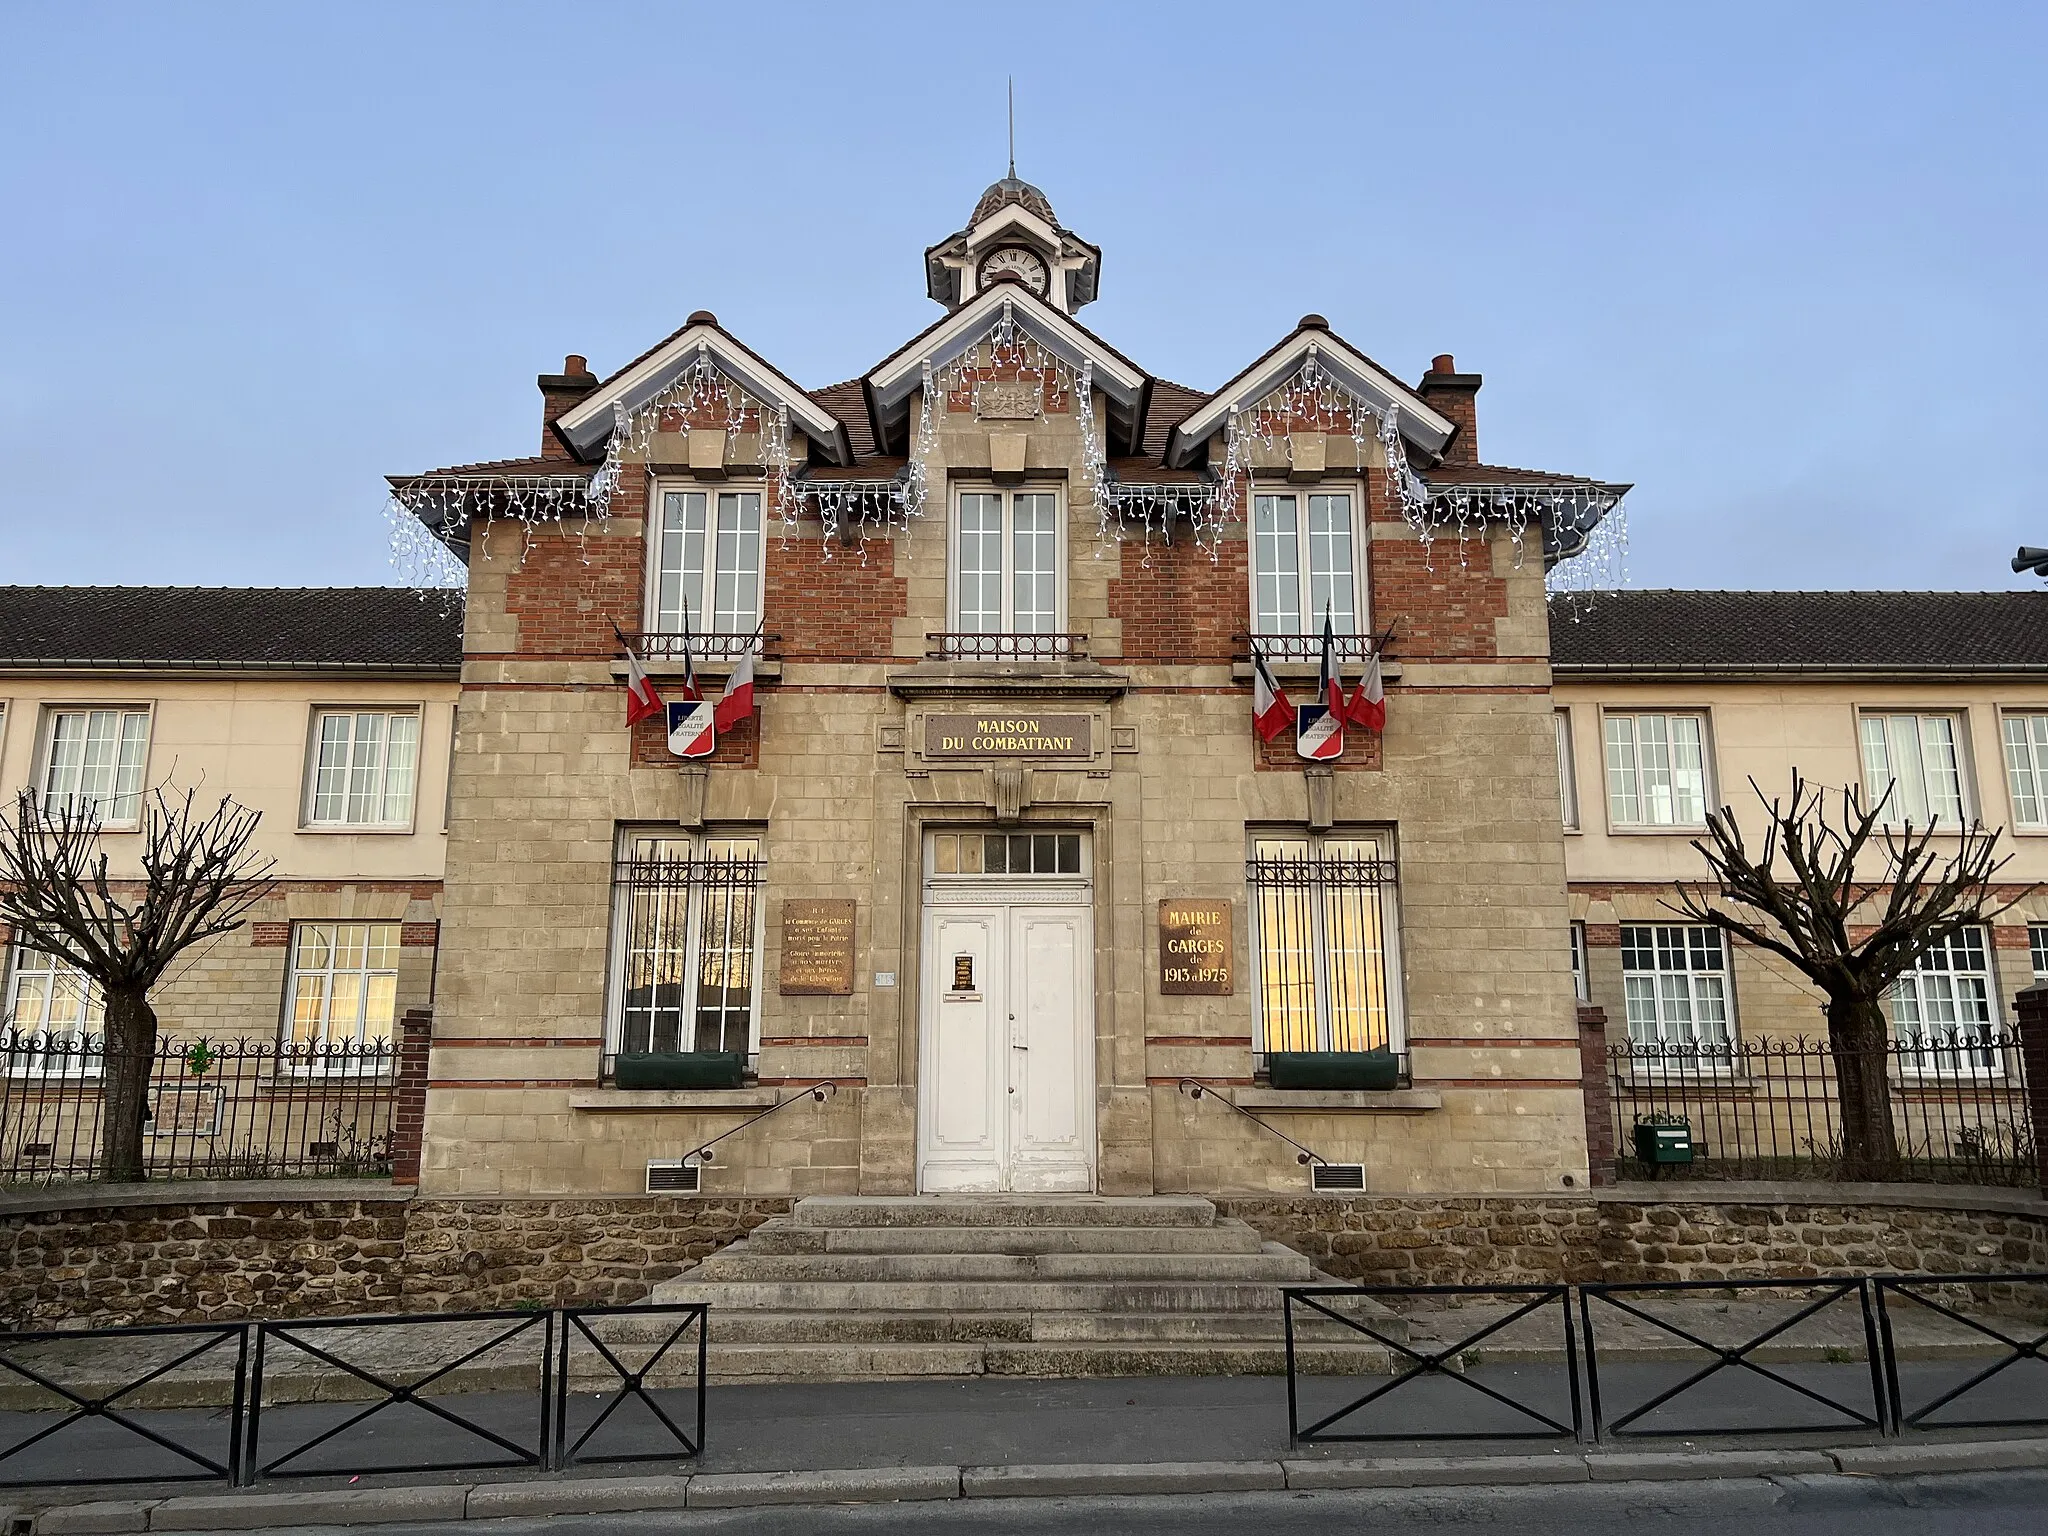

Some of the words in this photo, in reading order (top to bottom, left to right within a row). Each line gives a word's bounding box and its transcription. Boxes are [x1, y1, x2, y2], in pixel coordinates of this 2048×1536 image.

[977, 720, 1039, 733] MAISON
[942, 737, 964, 750] DU
[972, 737, 1073, 750] COMBATTANT
[1170, 912, 1220, 924] MAIRIE
[1190, 926, 1202, 936] de
[1168, 940, 1224, 954] GARGES
[1190, 954, 1202, 964] de
[1164, 968, 1190, 982] 1913
[1199, 968, 1228, 982] 1975
